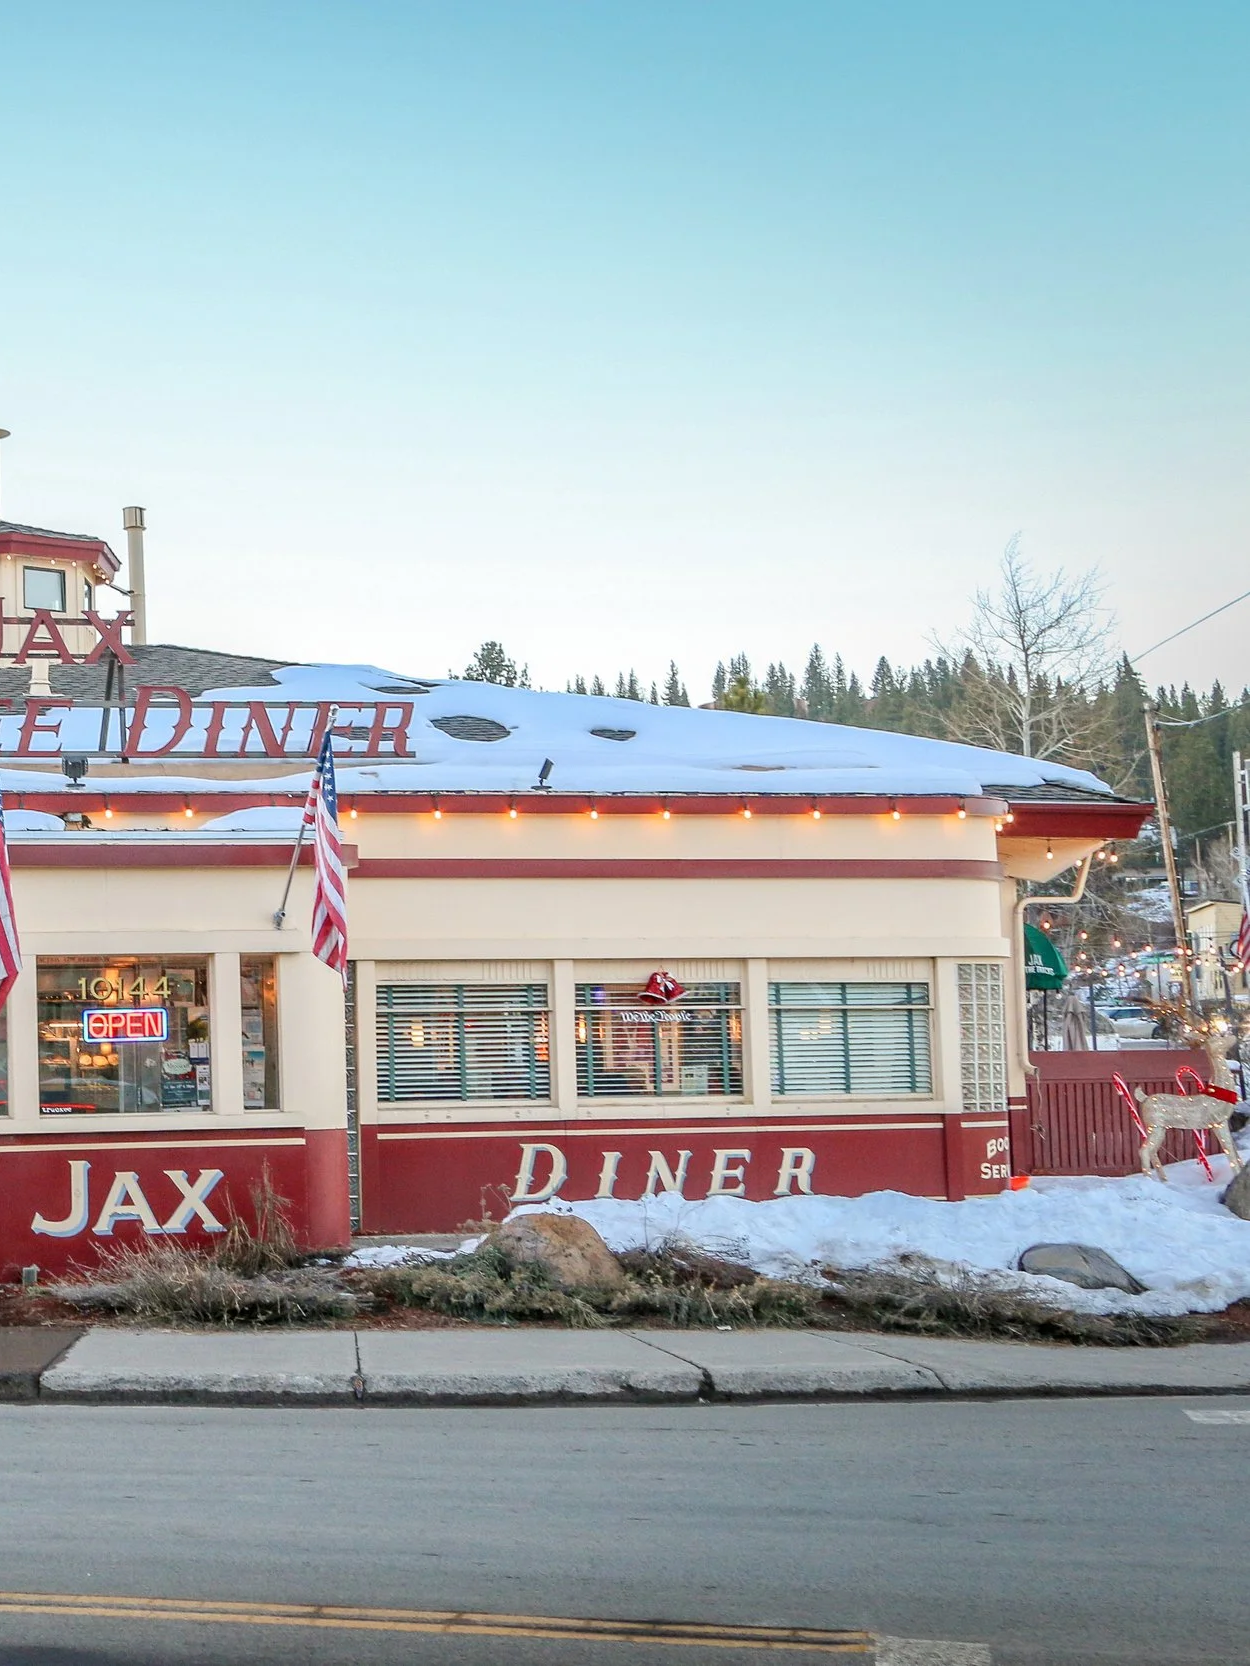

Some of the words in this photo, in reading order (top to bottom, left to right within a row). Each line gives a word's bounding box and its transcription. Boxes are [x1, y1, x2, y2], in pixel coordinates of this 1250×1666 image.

[123, 685, 414, 758] DINER
[78, 976, 172, 1000] 10144
[88, 1011, 163, 1038] OPEN
[31, 1160, 227, 1238] JAX
[510, 1143, 816, 1202] DINER
